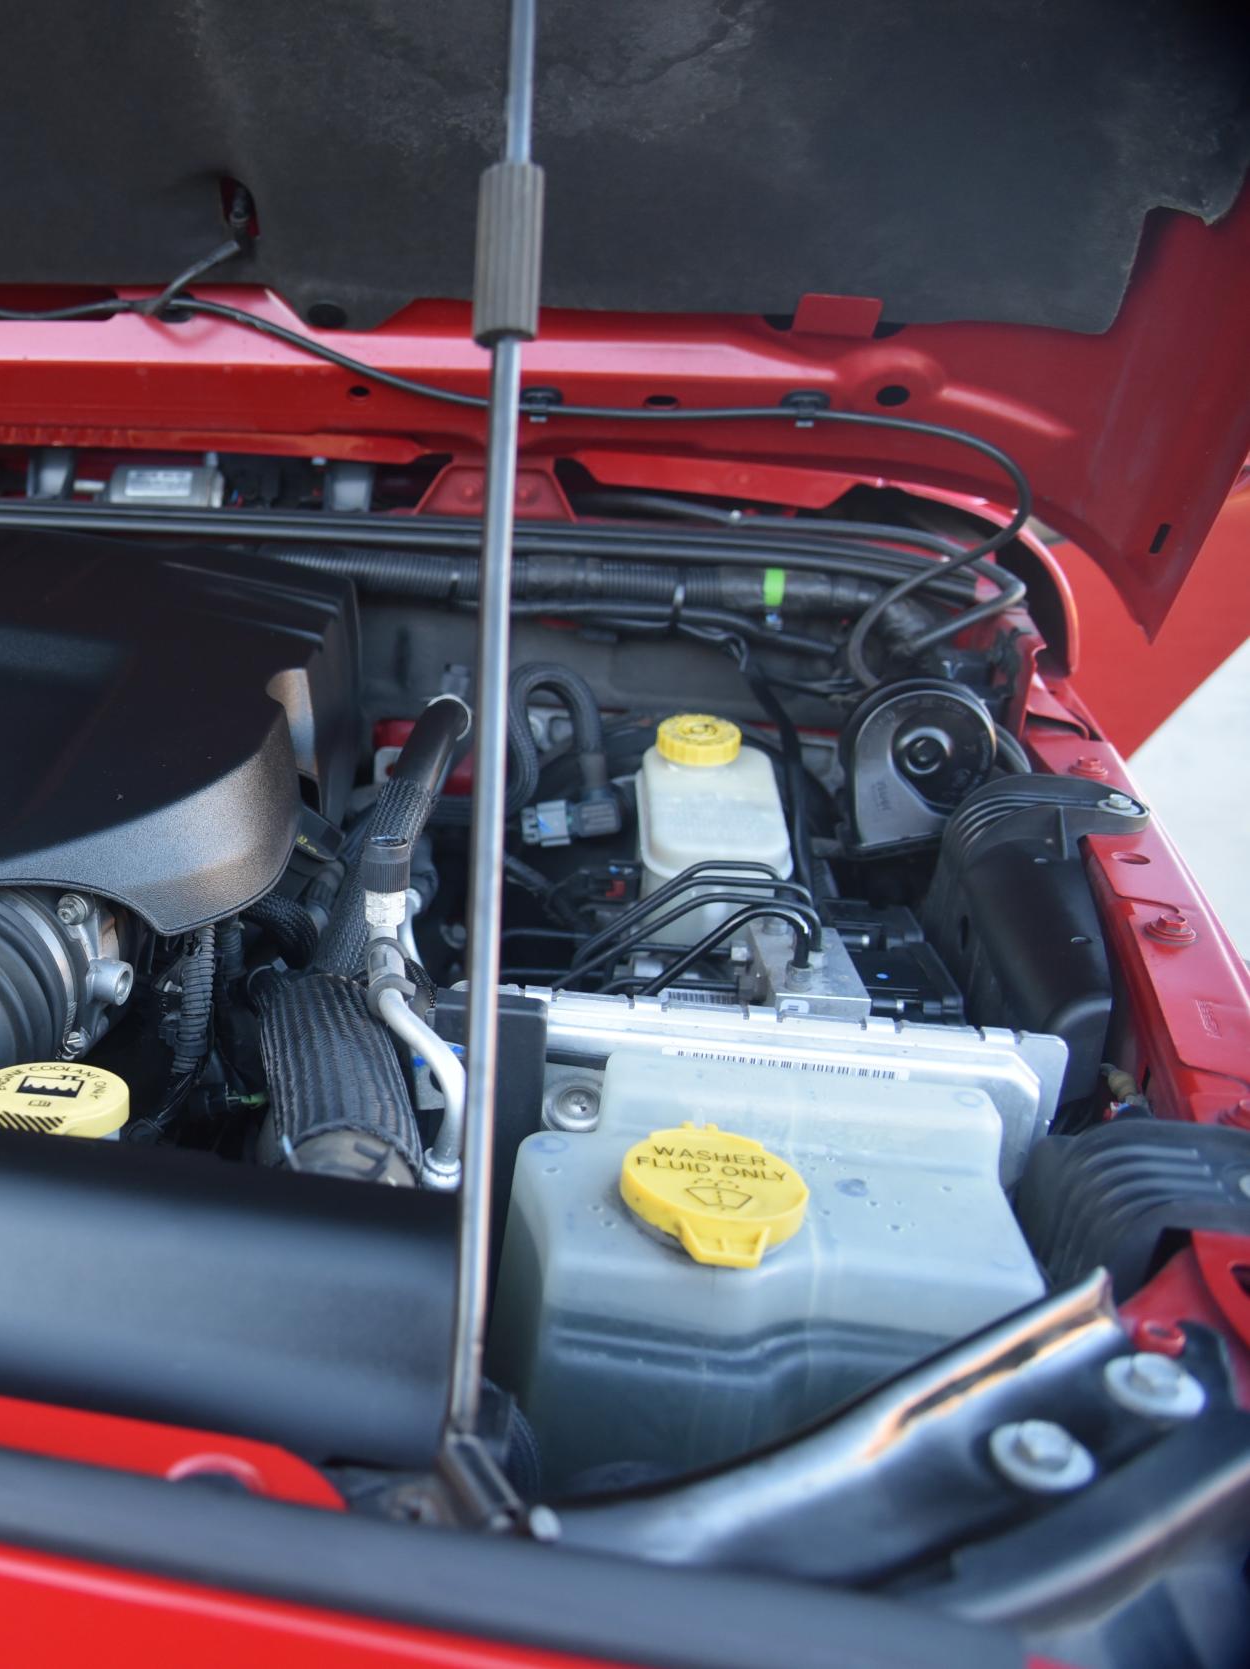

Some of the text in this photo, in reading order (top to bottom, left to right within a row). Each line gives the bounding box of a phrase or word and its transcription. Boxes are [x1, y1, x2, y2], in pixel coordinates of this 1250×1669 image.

[28, 1065, 101, 1080] COOLANT
[90, 1080, 107, 1100] ONLY
[653, 1145, 767, 1166] WASHER
[636, 1156, 788, 1182] FLUID ONLY
